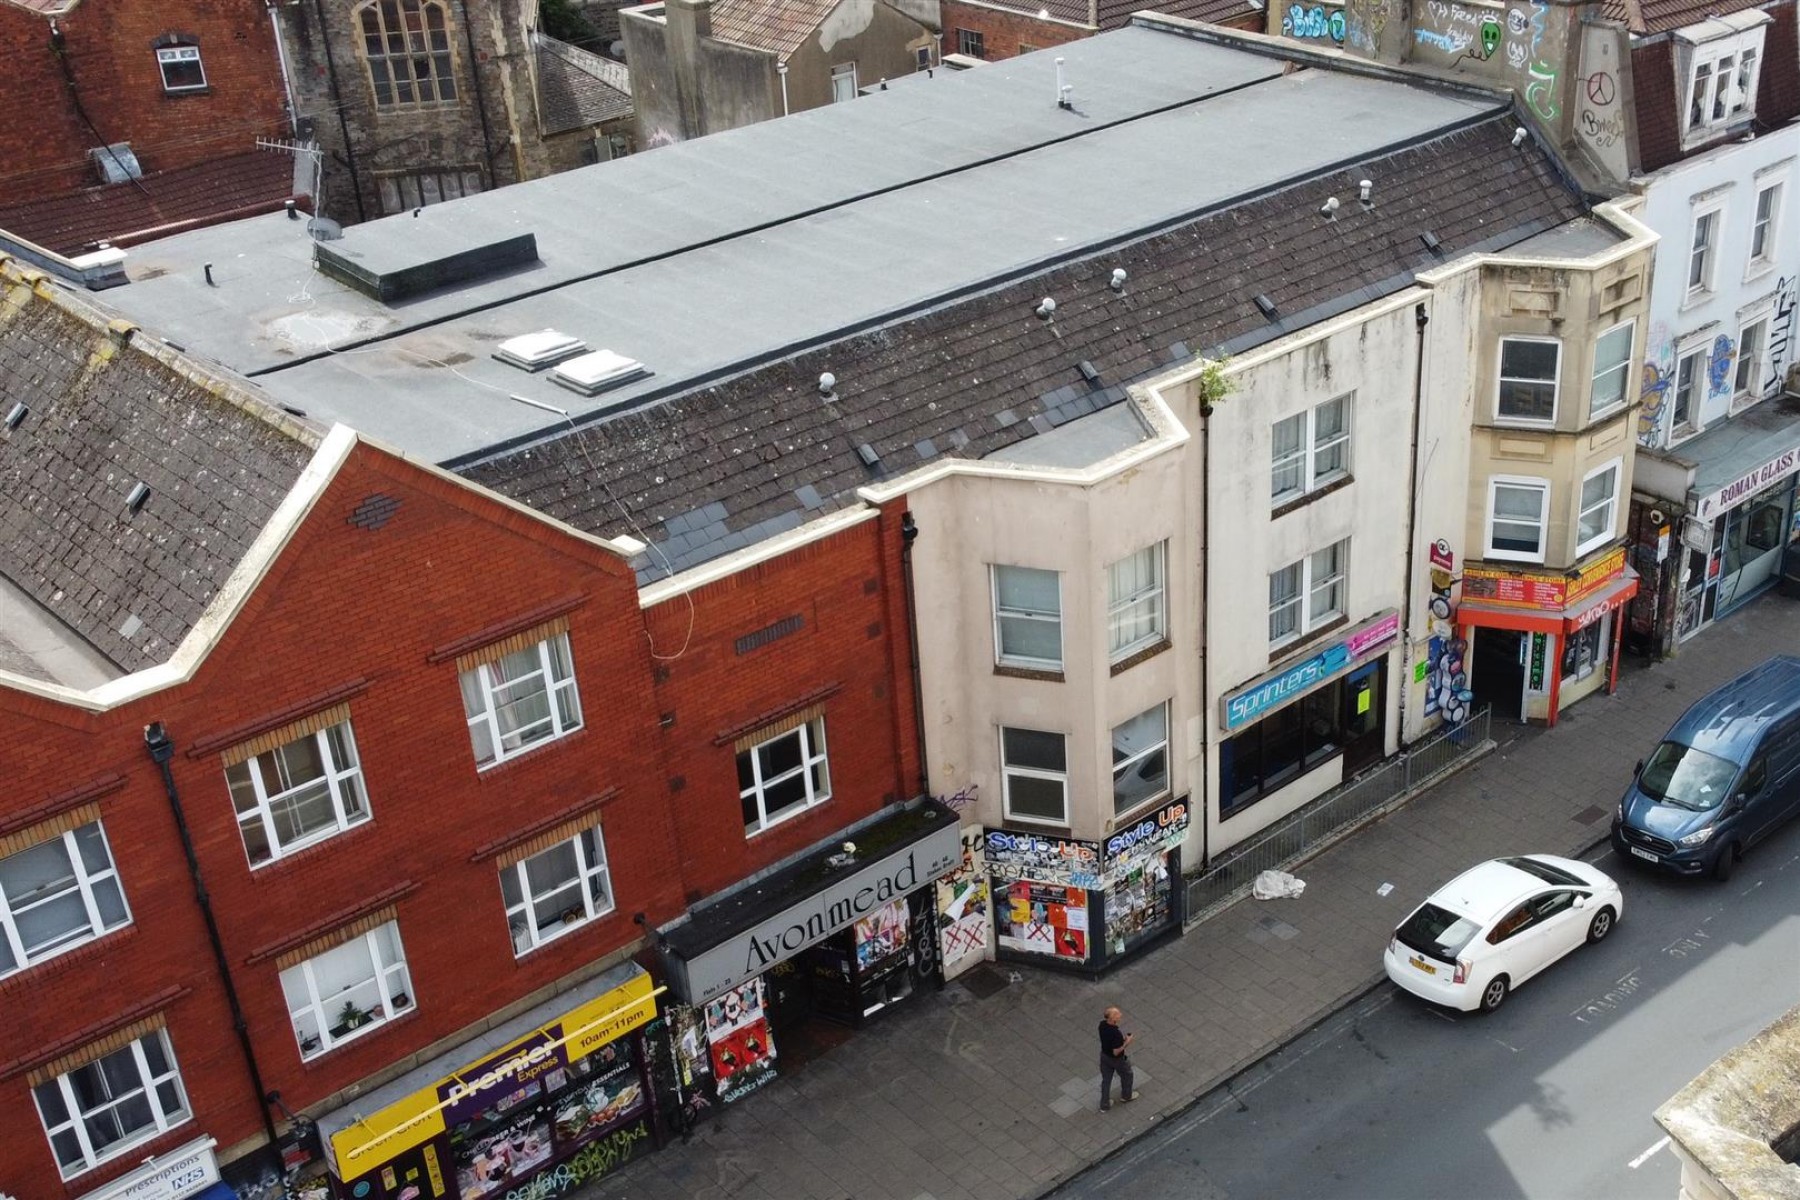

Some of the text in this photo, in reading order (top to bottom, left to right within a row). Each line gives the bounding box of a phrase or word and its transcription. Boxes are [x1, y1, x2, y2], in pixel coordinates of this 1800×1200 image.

[1720, 469, 1759, 506] ROMAN
[1761, 450, 1795, 483] GLASS
[1231, 660, 1319, 720] Sprinters
[1058, 840, 1097, 862] Up
[1107, 803, 1186, 858] Style Up
[743, 850, 918, 975] Avonmead
[579, 1008, 645, 1049] 10am-11pm
[448, 1040, 555, 1107] Premier
[516, 1055, 559, 1084] Express
[592, 1061, 631, 1086] ESSENTIALS
[124, 1155, 200, 1197] Prescriptions
[173, 1166, 204, 1190] NHS
